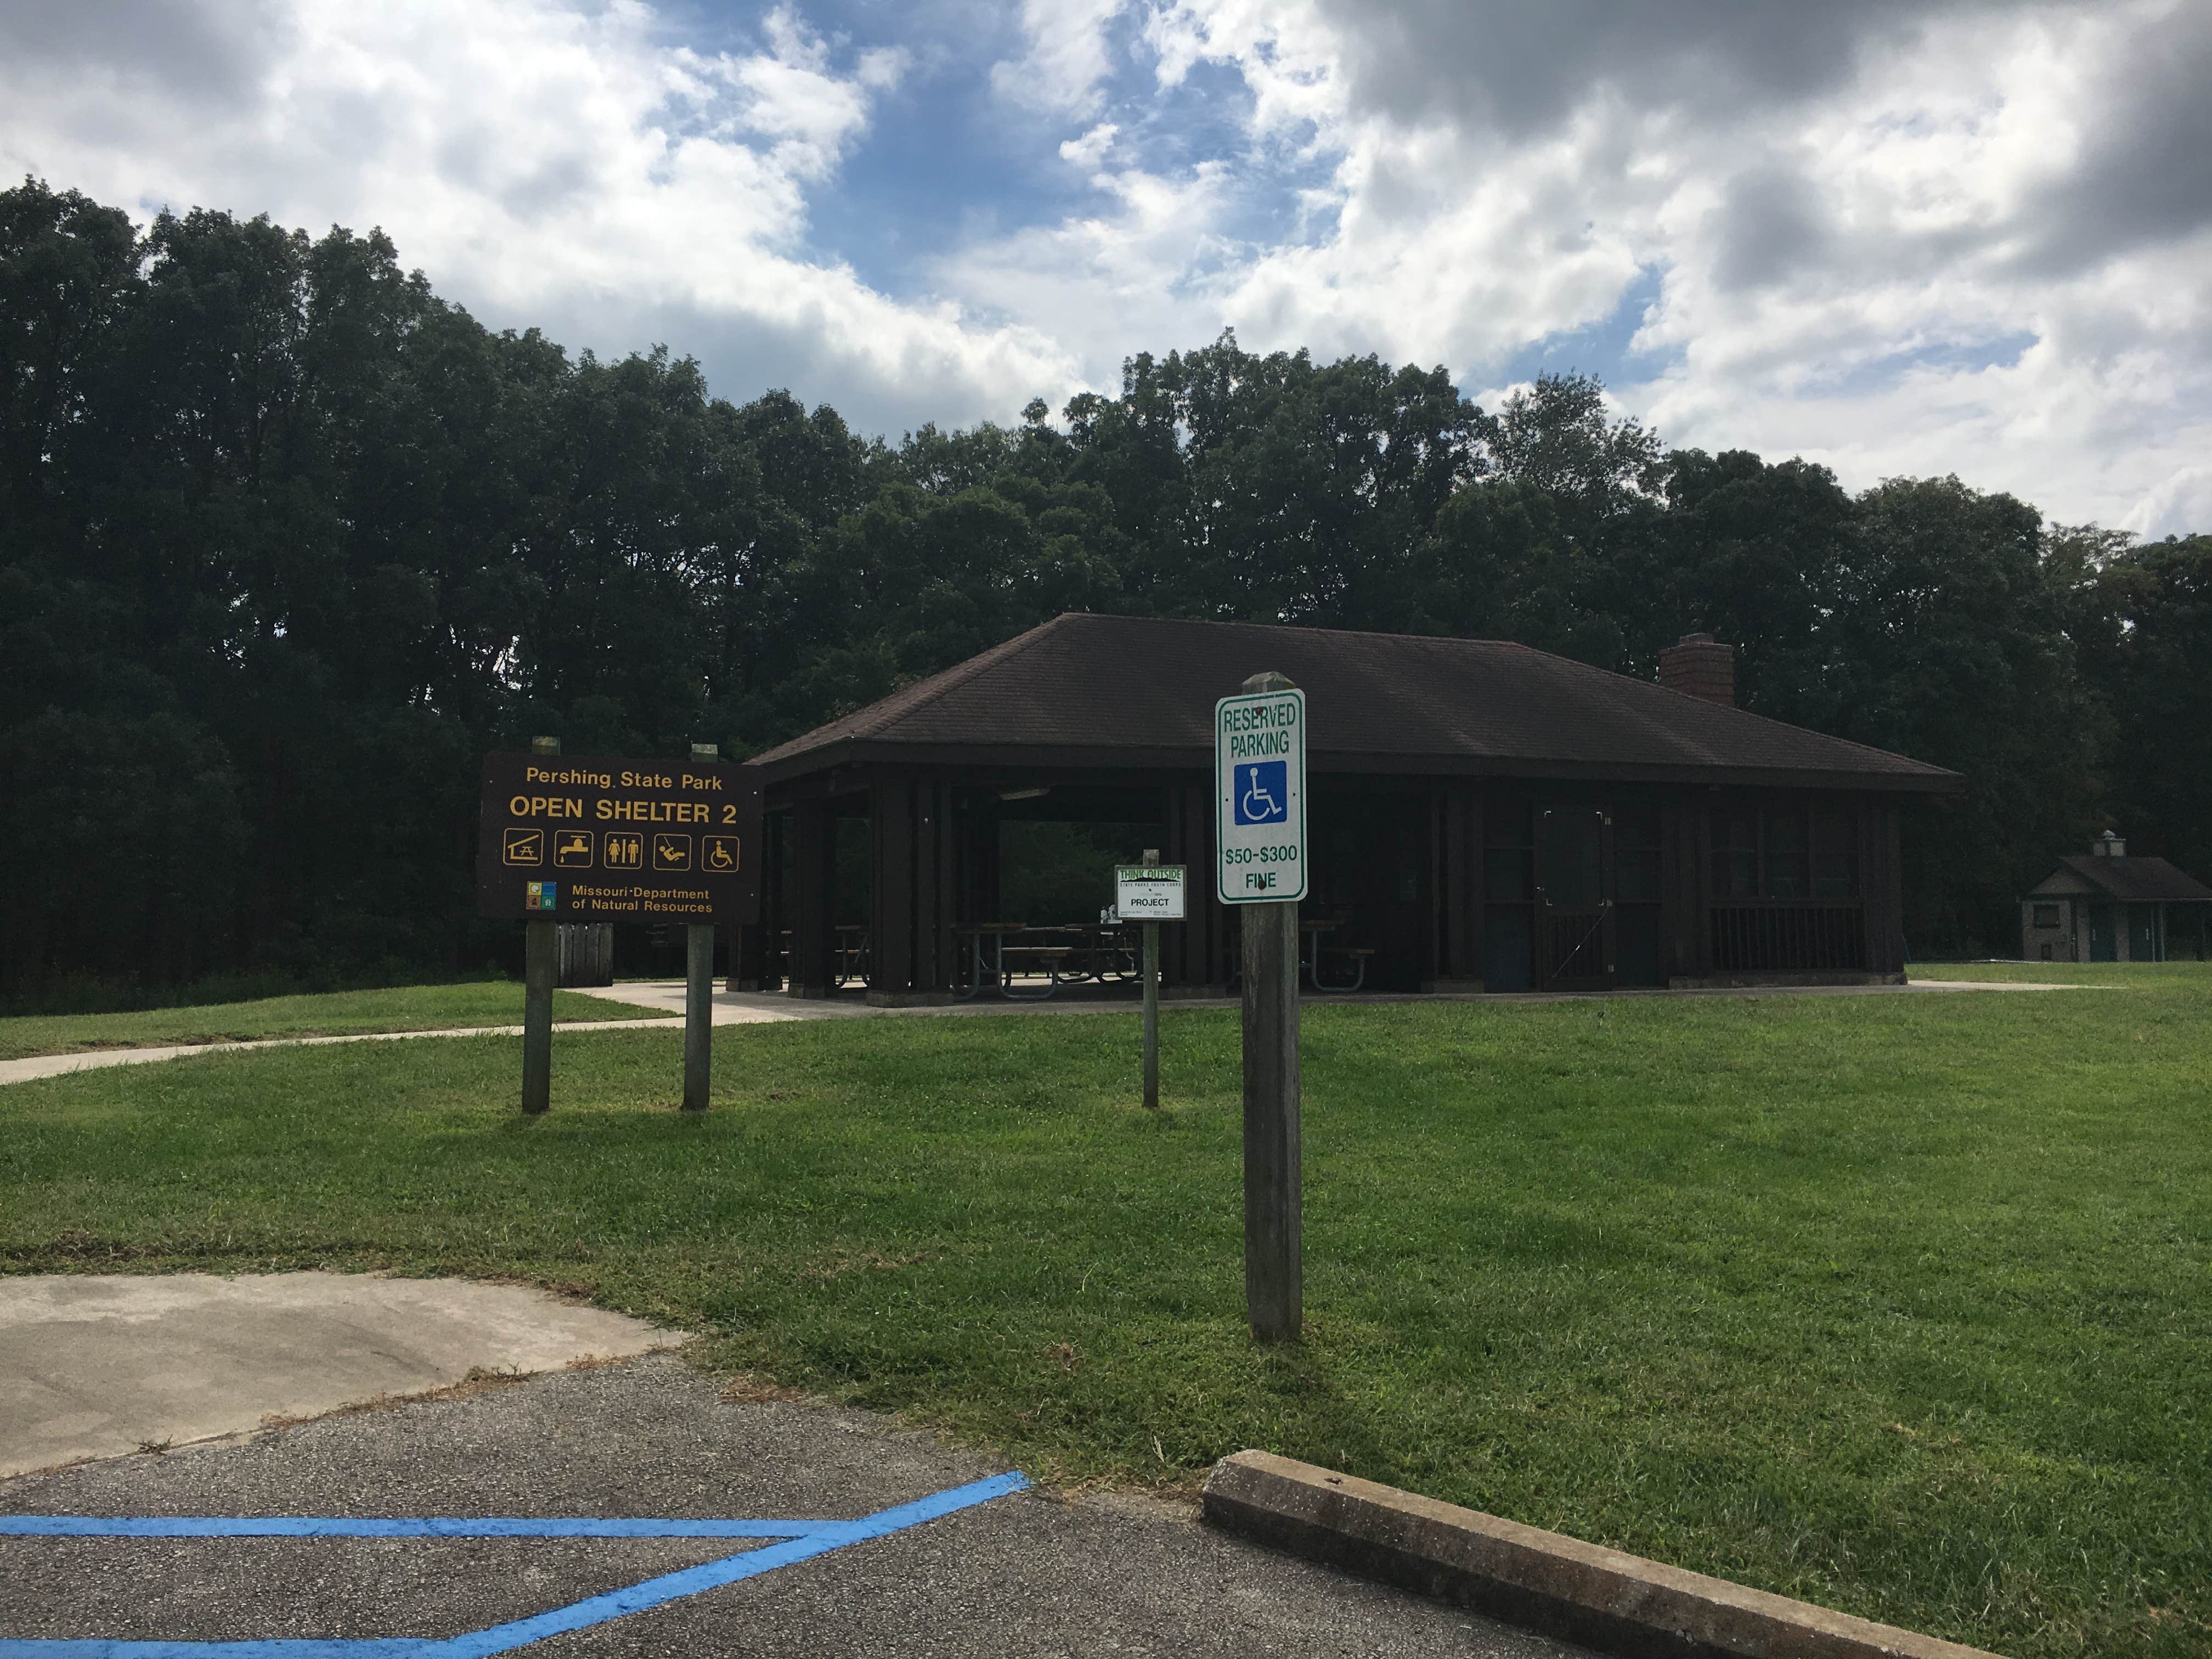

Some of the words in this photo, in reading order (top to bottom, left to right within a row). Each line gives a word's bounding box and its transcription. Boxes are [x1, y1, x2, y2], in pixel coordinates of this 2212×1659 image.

[1224, 703, 1296, 733] RESERVED
[1231, 731, 1289, 758] PARKING
[527, 767, 611, 789] Pershing
[620, 771, 673, 789] State
[682, 775, 723, 791] Park
[509, 795, 583, 818] OPEN
[596, 799, 710, 824] SHELTER
[722, 805, 737, 824] 2
[1226, 845, 1297, 865] $50-$300
[1120, 870, 1144, 879] THINK
[1148, 870, 1181, 879] OUTSIDE
[1246, 872, 1277, 889] FINE
[572, 885, 628, 897] Missouri
[634, 887, 709, 899] Department
[572, 899, 587, 910] of
[592, 899, 638, 911] Natural
[644, 901, 713, 913] Resources
